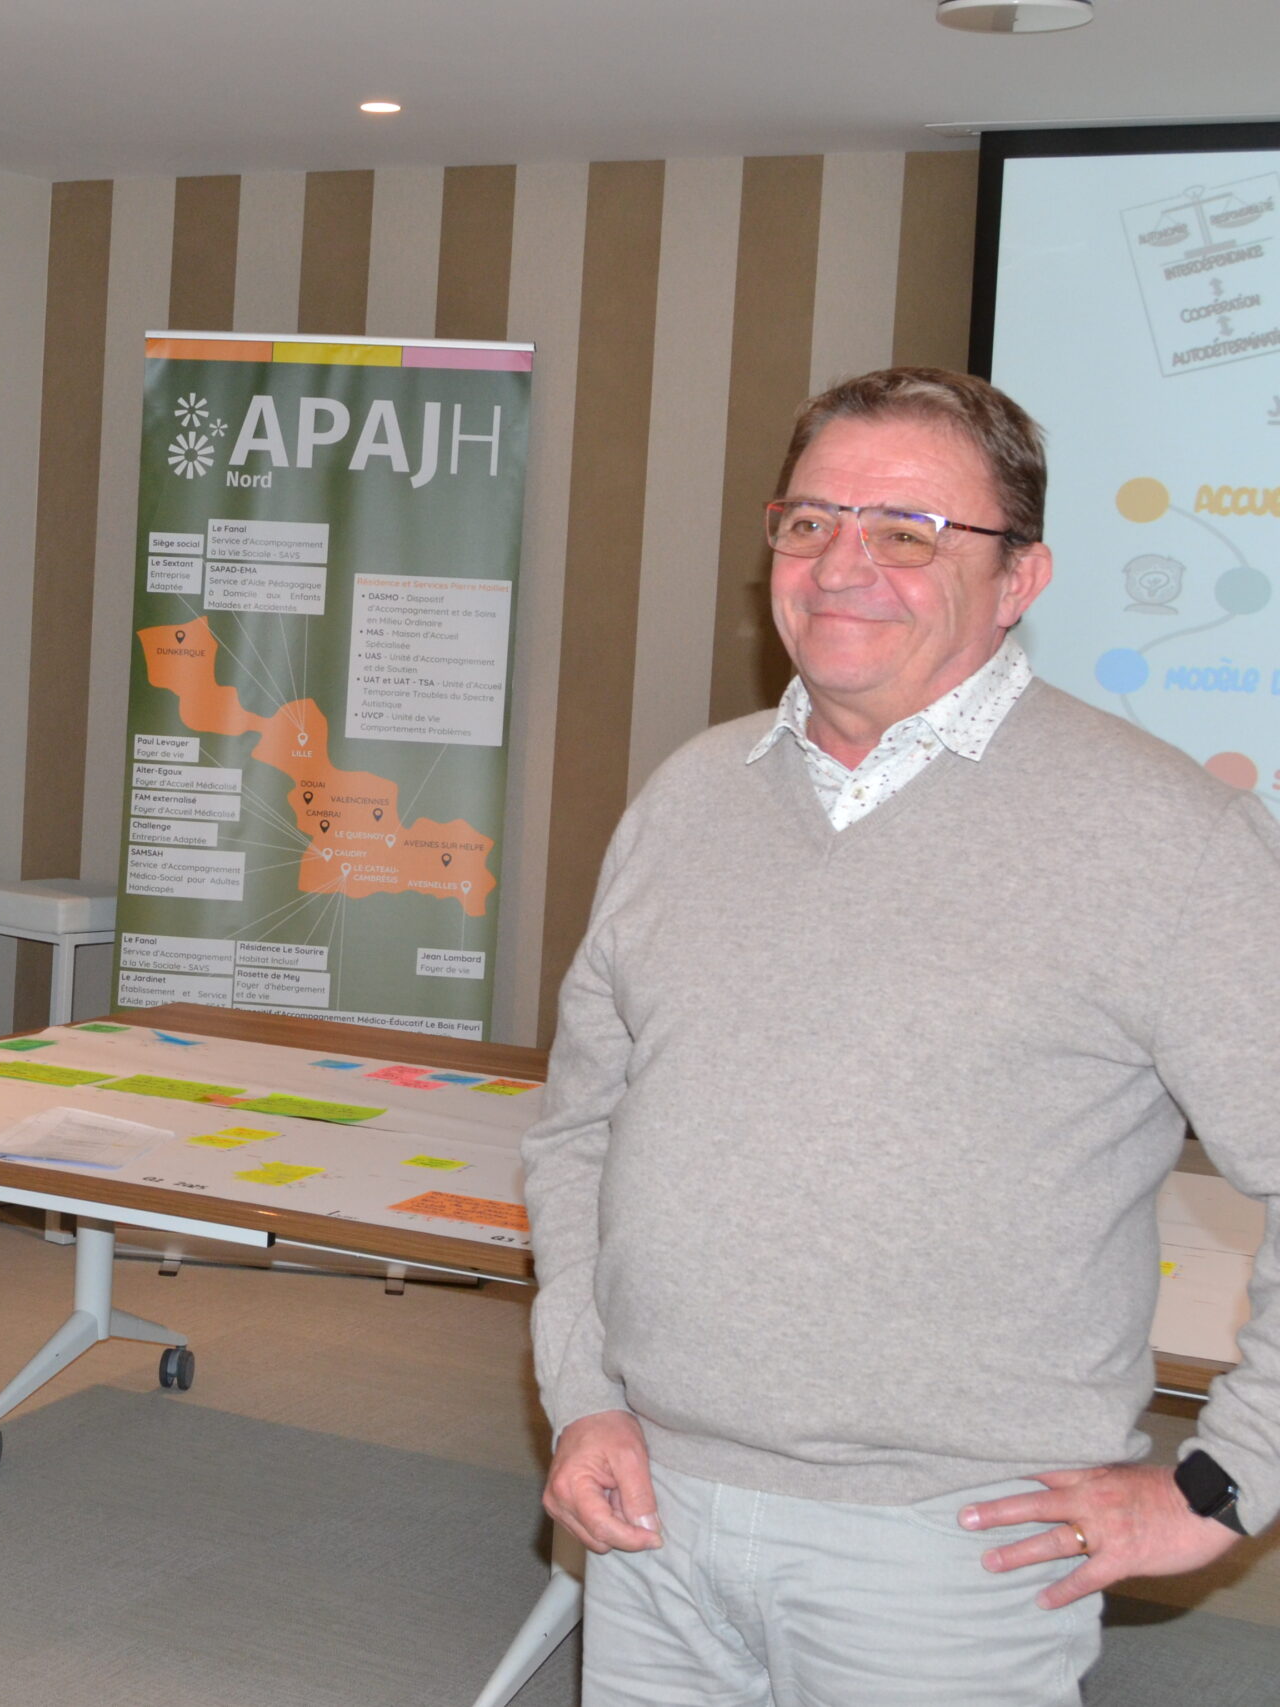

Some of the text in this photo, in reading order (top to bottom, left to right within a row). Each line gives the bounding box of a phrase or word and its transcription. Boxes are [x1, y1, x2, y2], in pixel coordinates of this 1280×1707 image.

[1164, 244, 1264, 280] INTERDÉPENDANCE
[1180, 294, 1261, 323] COOPÉRATION
[228, 395, 501, 488] APAJH
[226, 471, 272, 488] Nord
[224, 525, 247, 533] Fanal
[153, 539, 200, 548] Siège social
[212, 537, 322, 549] Service d'Accompagnement
[242, 550, 271, 558] Sociale
[279, 551, 301, 559] SAVS
[151, 571, 190, 580] Entreprise
[150, 583, 182, 592] Adaptée
[241, 578, 265, 586] d'Aide
[269, 580, 321, 589] Pédagogique
[223, 590, 257, 598] Domicile
[392, 630, 420, 638] Maison
[423, 632, 458, 640] d'Accueil
[157, 648, 206, 657] DUNKERQUE
[387, 665, 417, 673] Soutien
[443, 680, 463, 688] Unité
[466, 681, 502, 690] d'Accueil
[137, 737, 154, 745] Paul
[137, 749, 158, 758] Foyer
[136, 766, 182, 776] Alter-Egaux
[153, 795, 196, 804] externalisé
[331, 796, 389, 806] VALENCIENNES
[306, 810, 341, 818] CAMBRAI
[133, 821, 171, 831] Challenge
[132, 833, 206, 844] Entreprise Adaptée
[131, 849, 163, 857] SAMSAH
[130, 861, 240, 873] Service d'Accompagnement
[130, 872, 239, 886] Médico-Social pour Adultes
[129, 883, 174, 893] Handicapés
[240, 942, 280, 953] Résidence
[295, 947, 324, 955] Sourire
[123, 947, 232, 961] Service d'Accompagnement
[152, 961, 180, 970] Sociale
[189, 964, 210, 972] SAVS
[420, 964, 444, 974] Foyer
[133, 975, 166, 983] Jardinet
[237, 969, 268, 979] Rosette
[283, 973, 300, 982] Mey
[121, 983, 175, 995] Établissement
[198, 991, 227, 999] Service
[237, 981, 325, 994] Foyer d'hébergement
[246, 991, 256, 999] de
[357, 1016, 423, 1027] Médico-Éducatif
[438, 1022, 454, 1030] Bois
[457, 1023, 480, 1031] Fleuri
